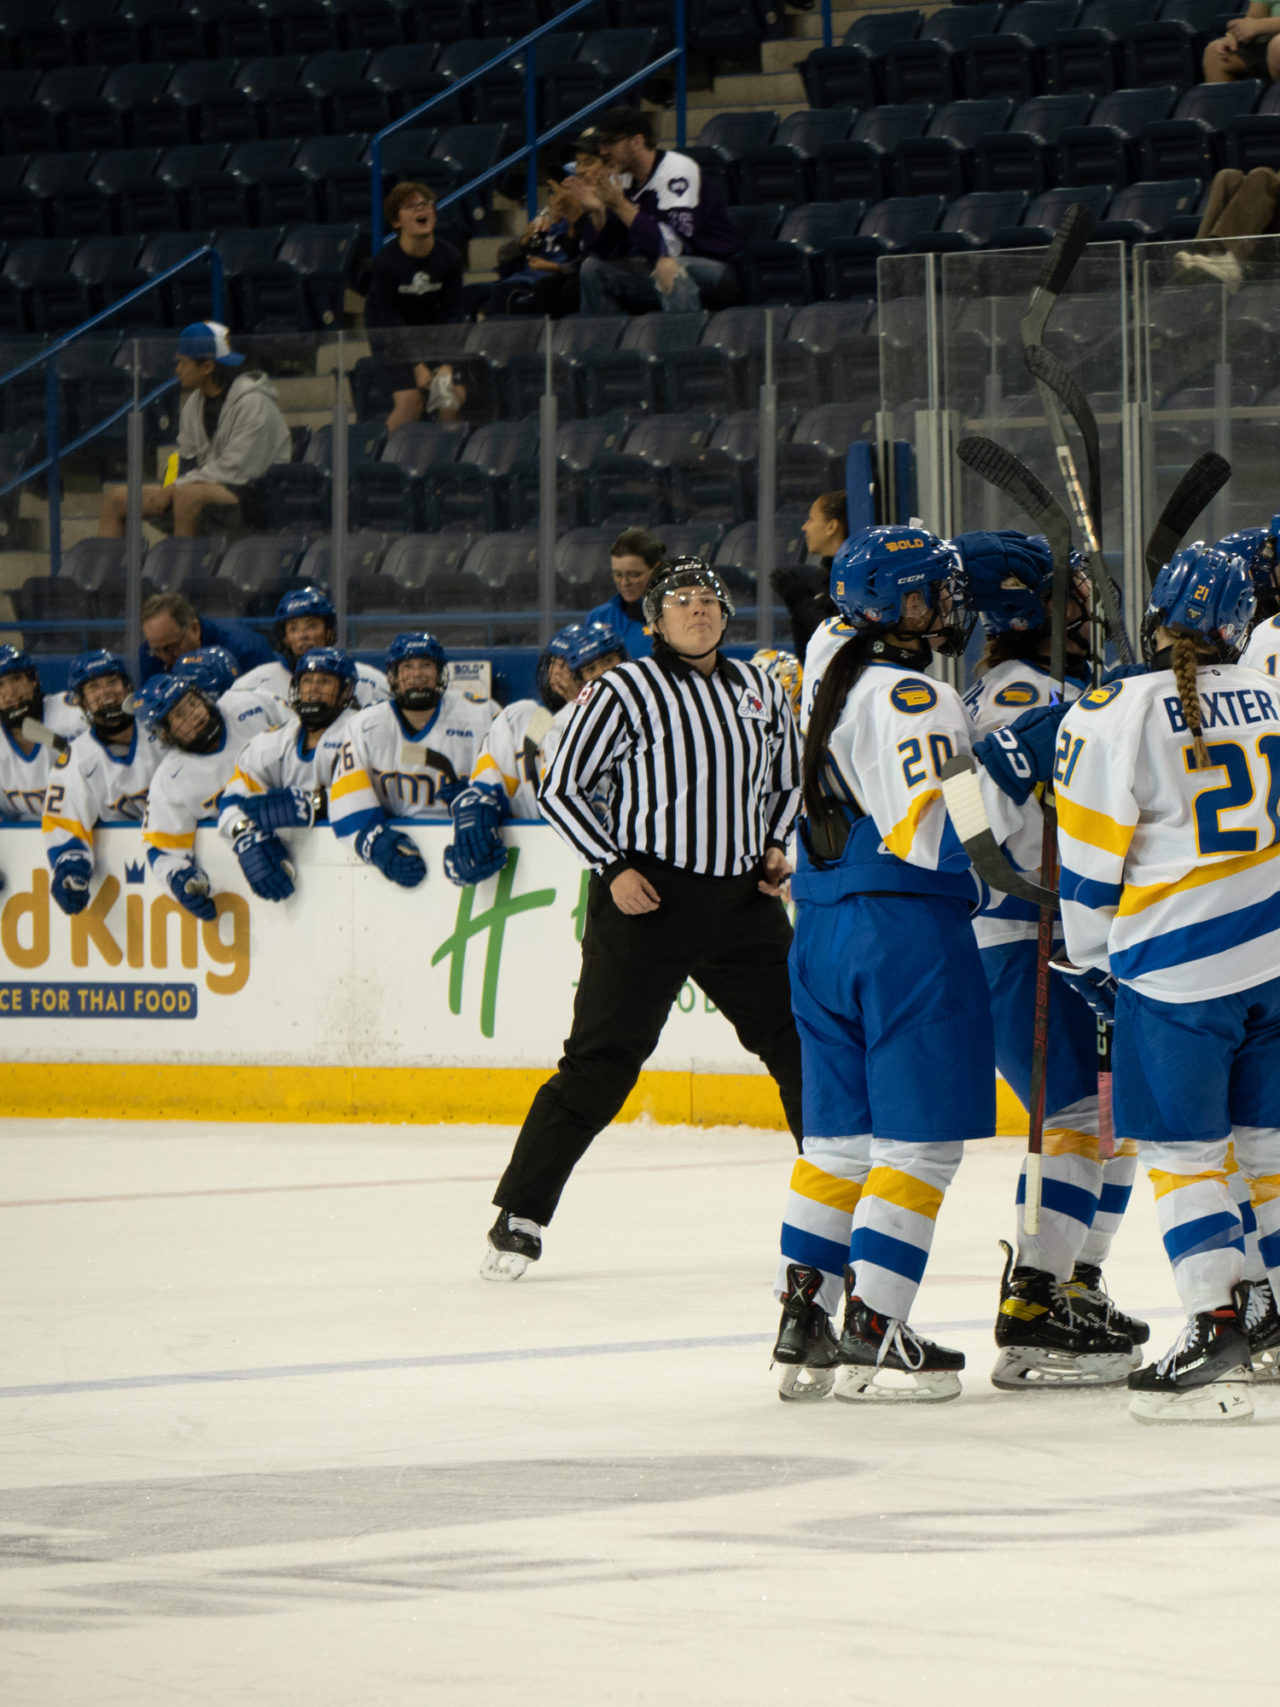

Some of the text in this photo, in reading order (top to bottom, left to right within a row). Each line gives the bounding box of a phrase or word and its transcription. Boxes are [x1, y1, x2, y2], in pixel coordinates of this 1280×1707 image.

[884, 537, 925, 552] BOLD
[897, 572, 926, 585] CCM
[1193, 584, 1210, 602] 21
[897, 734, 953, 789] 20
[1053, 729, 1087, 789] 21
[71, 875, 250, 995] King
[0, 990, 191, 1013] CE FOR THAI FOOD
[1033, 914, 1052, 1050] JETSPEED
